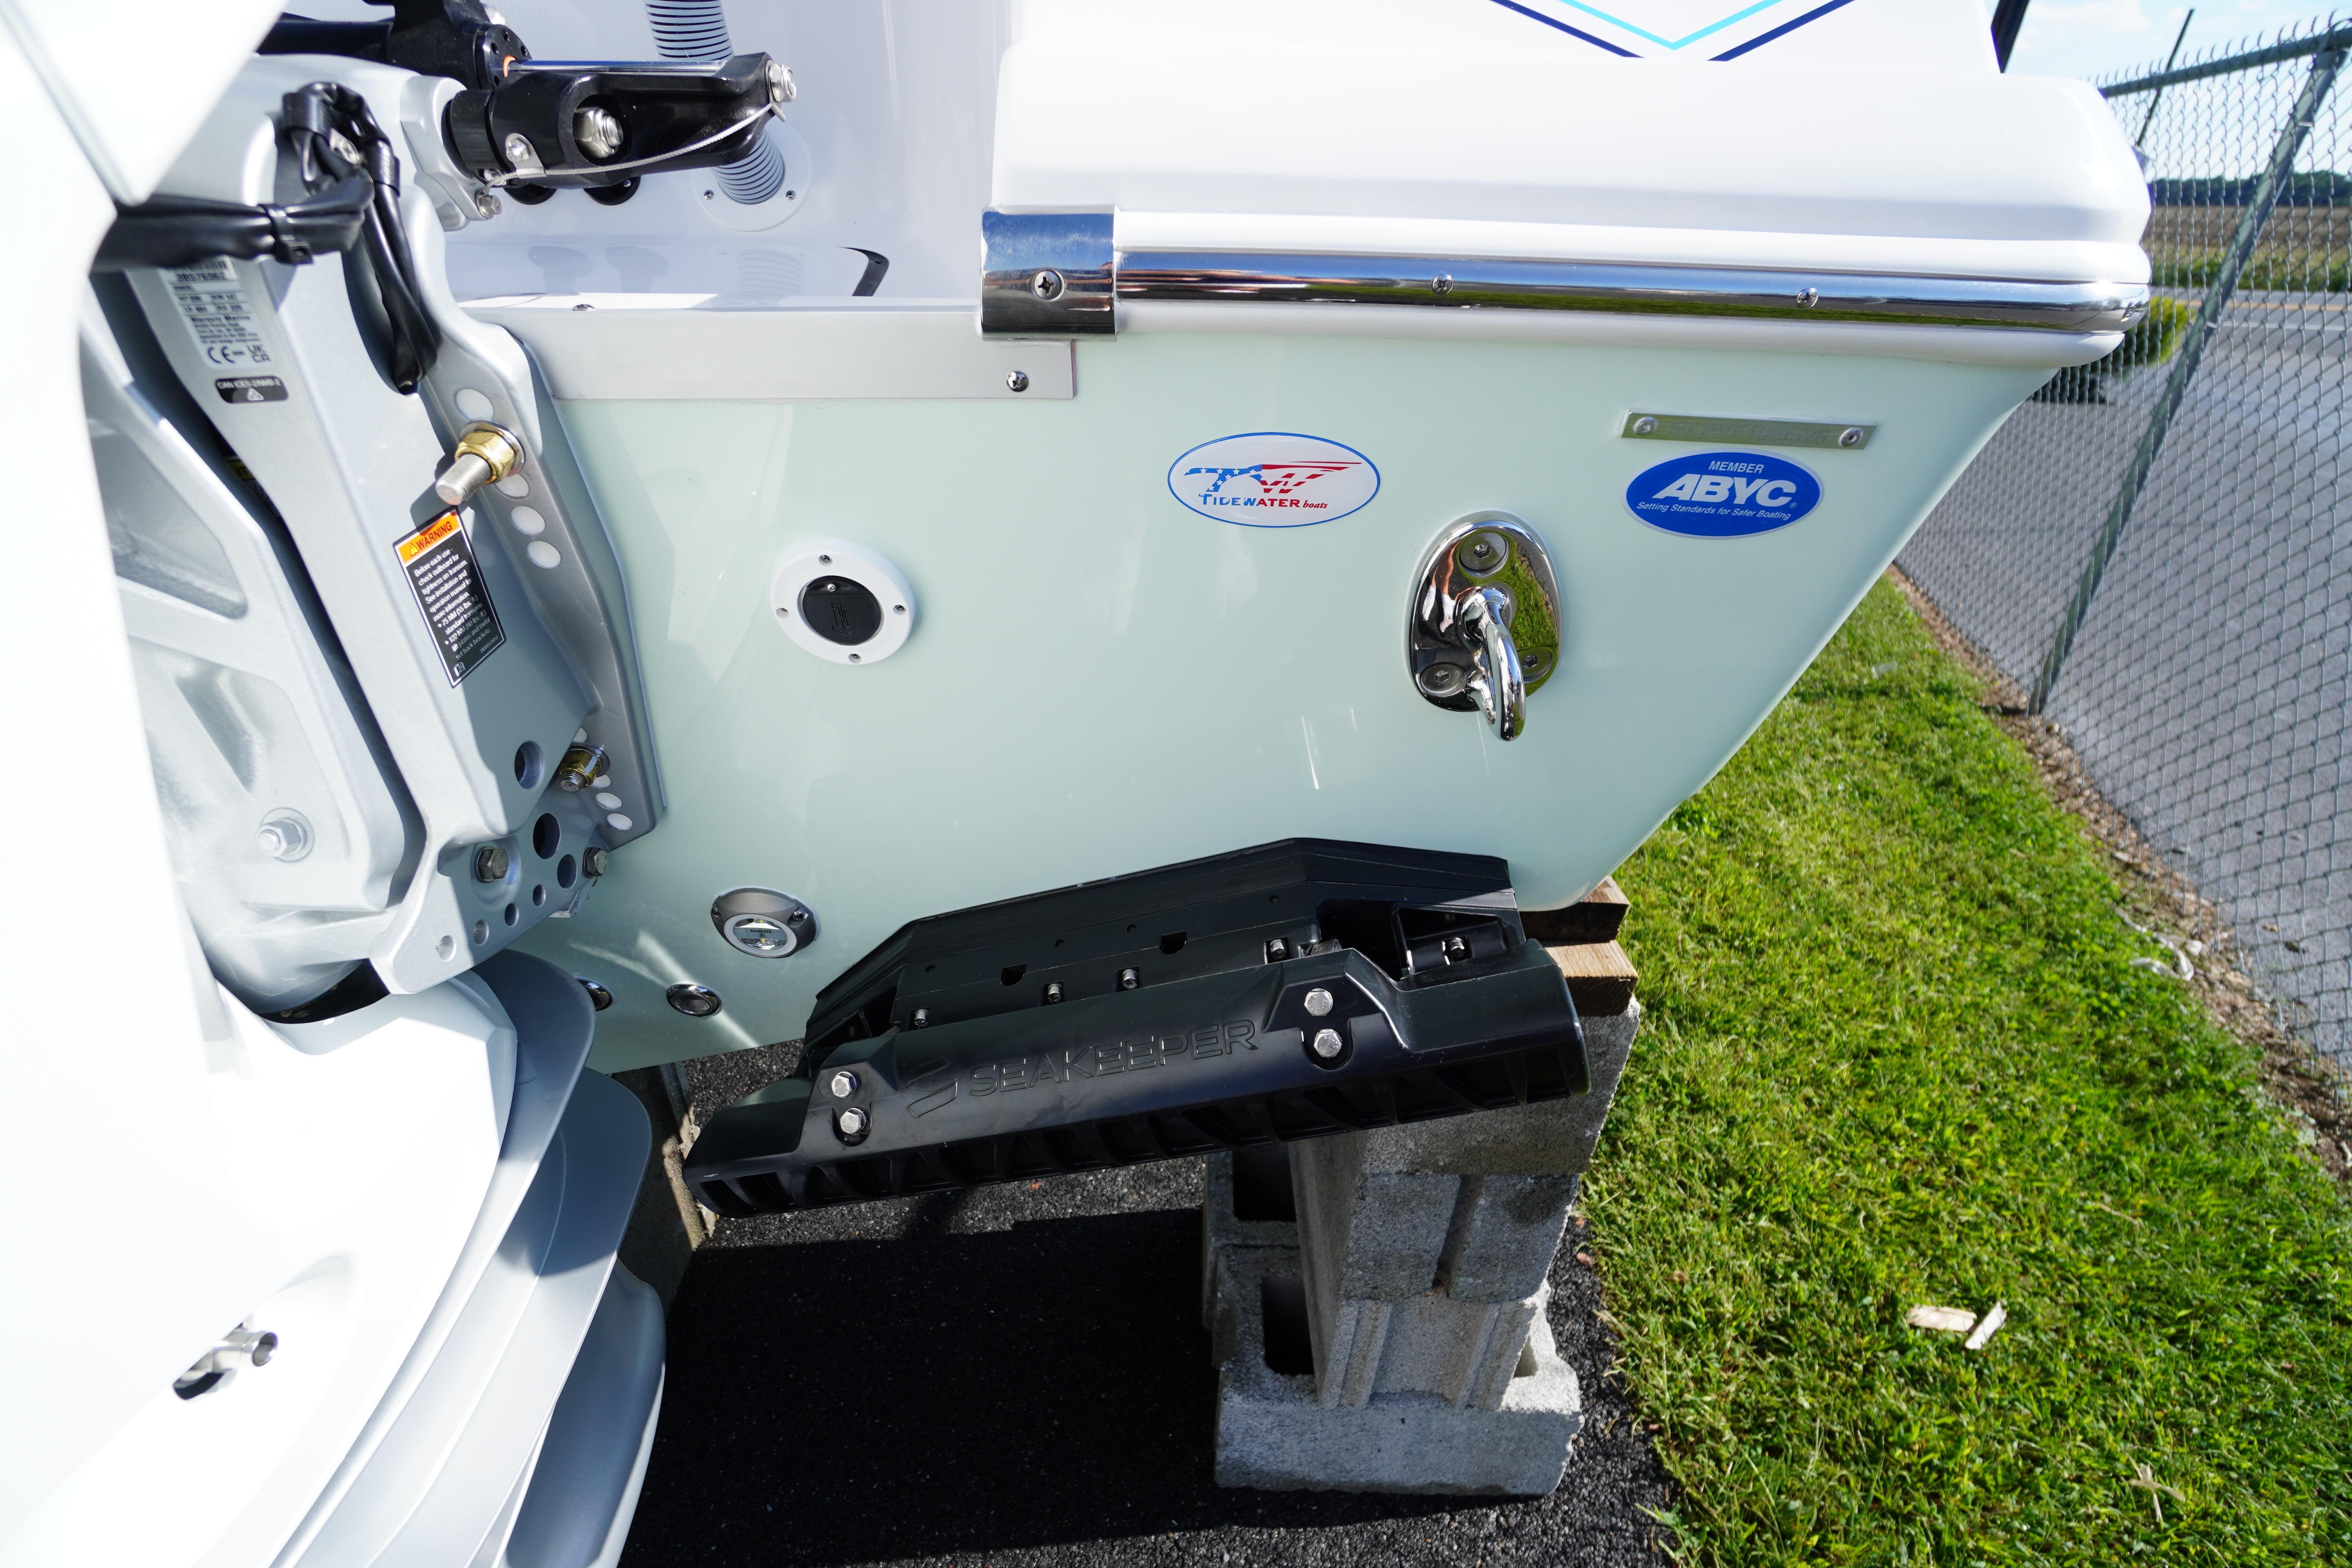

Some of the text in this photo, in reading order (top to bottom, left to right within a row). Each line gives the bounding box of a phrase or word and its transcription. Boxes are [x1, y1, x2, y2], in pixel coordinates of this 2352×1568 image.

[1708, 461, 1764, 474] MEMBER
[1303, 500, 1328, 508] boats
[1637, 501, 1669, 512] Setting
[1671, 504, 1716, 514] Standards
[1732, 508, 1756, 517] Safer
[1757, 510, 1791, 521] Boating
[416, 521, 452, 550] WARNING
[414, 562, 430, 577] Before
[429, 554, 442, 566] each
[441, 549, 450, 558] use
[418, 572, 433, 586] check
[432, 558, 453, 577] outboard
[422, 577, 444, 597] tightness
[448, 559, 468, 576] transom.
[425, 570, 467, 604] See installation and
[429, 594, 451, 614] operation
[450, 582, 466, 597] manual
[433, 590, 470, 622] more information.
[441, 617, 448, 626] 75
[447, 611, 457, 622] NM
[456, 605, 464, 616] (55
[445, 601, 483, 635] standard transoms
[449, 633, 458, 643] 122
[457, 626, 466, 637] NM
[458, 633, 471, 648] plates
[471, 626, 479, 636] and
[479, 617, 490, 629] metal
[463, 642, 473, 654] back
[473, 627, 490, 645] brackets
[970, 1019, 1258, 1097] SEAKEEPER
